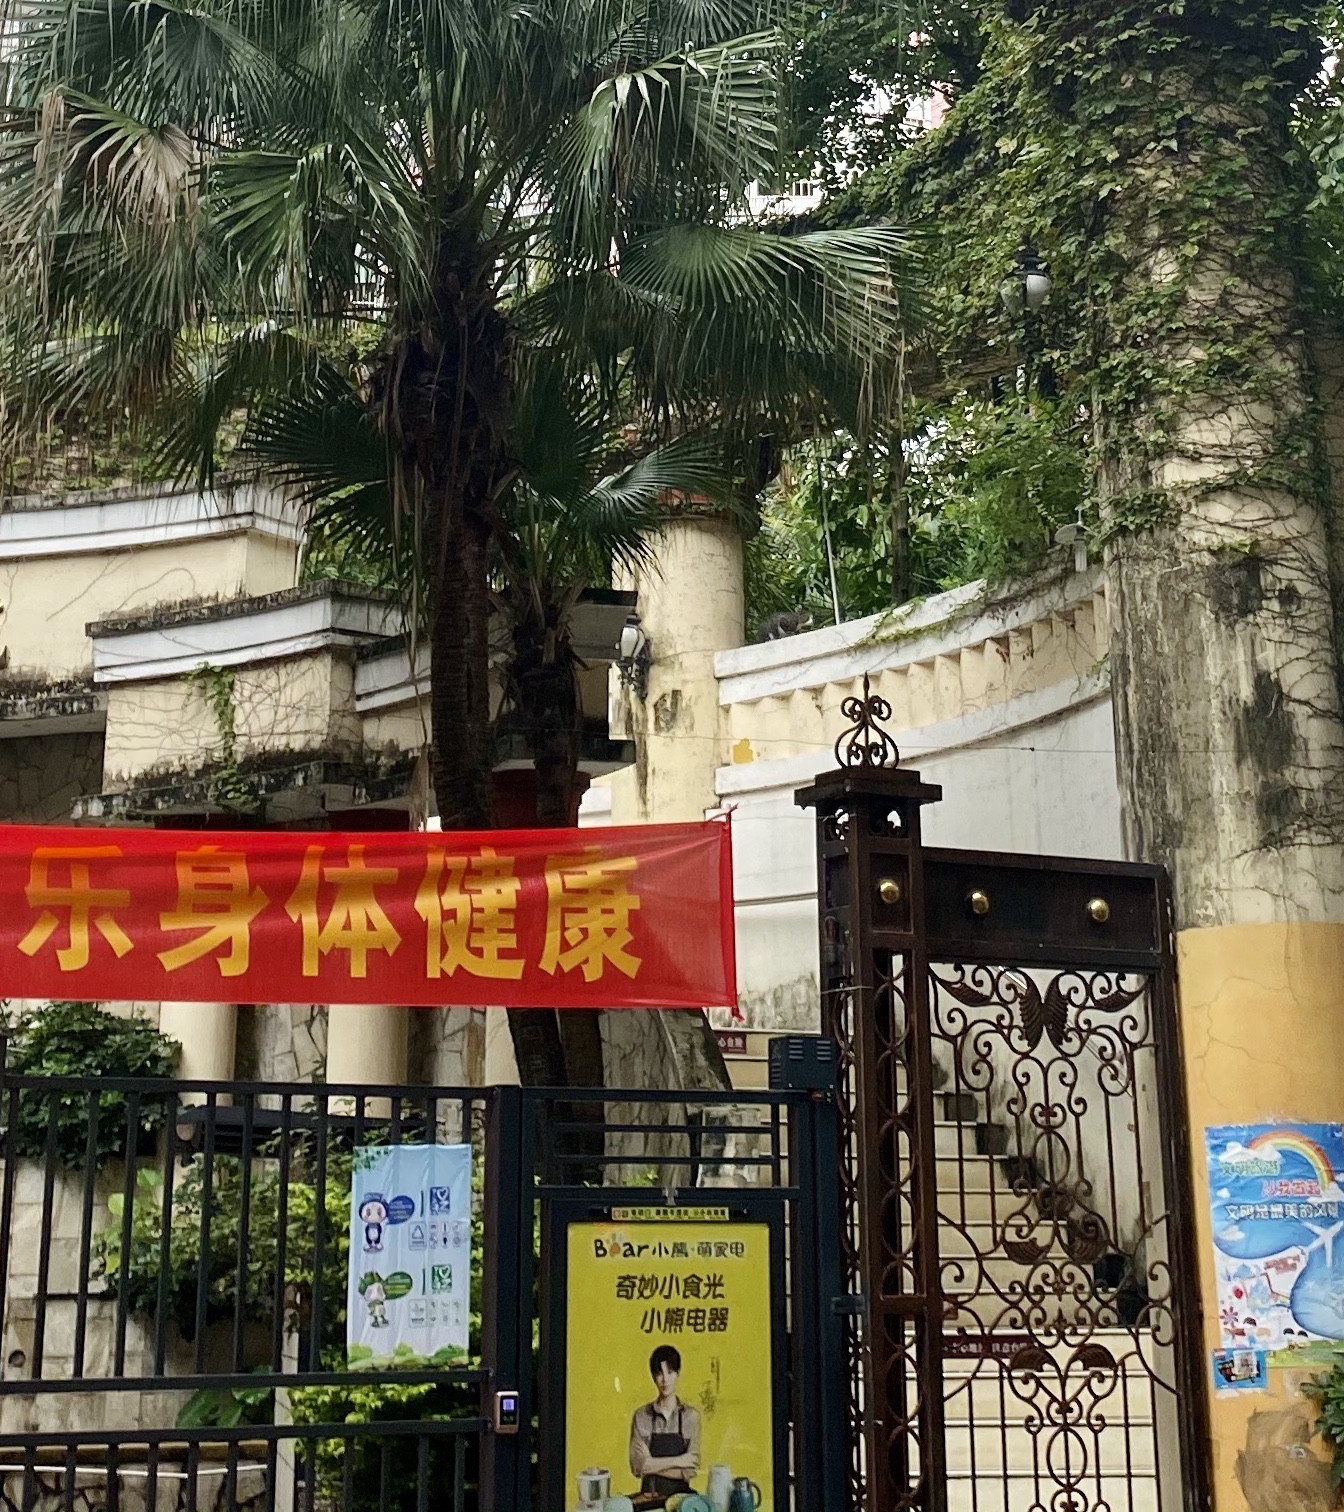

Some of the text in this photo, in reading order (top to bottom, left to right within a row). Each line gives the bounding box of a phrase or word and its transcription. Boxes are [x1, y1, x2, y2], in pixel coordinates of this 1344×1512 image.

[615, 1273, 725, 1300] 奇妙小食光
[641, 1307, 729, 1334] 小熊电器
